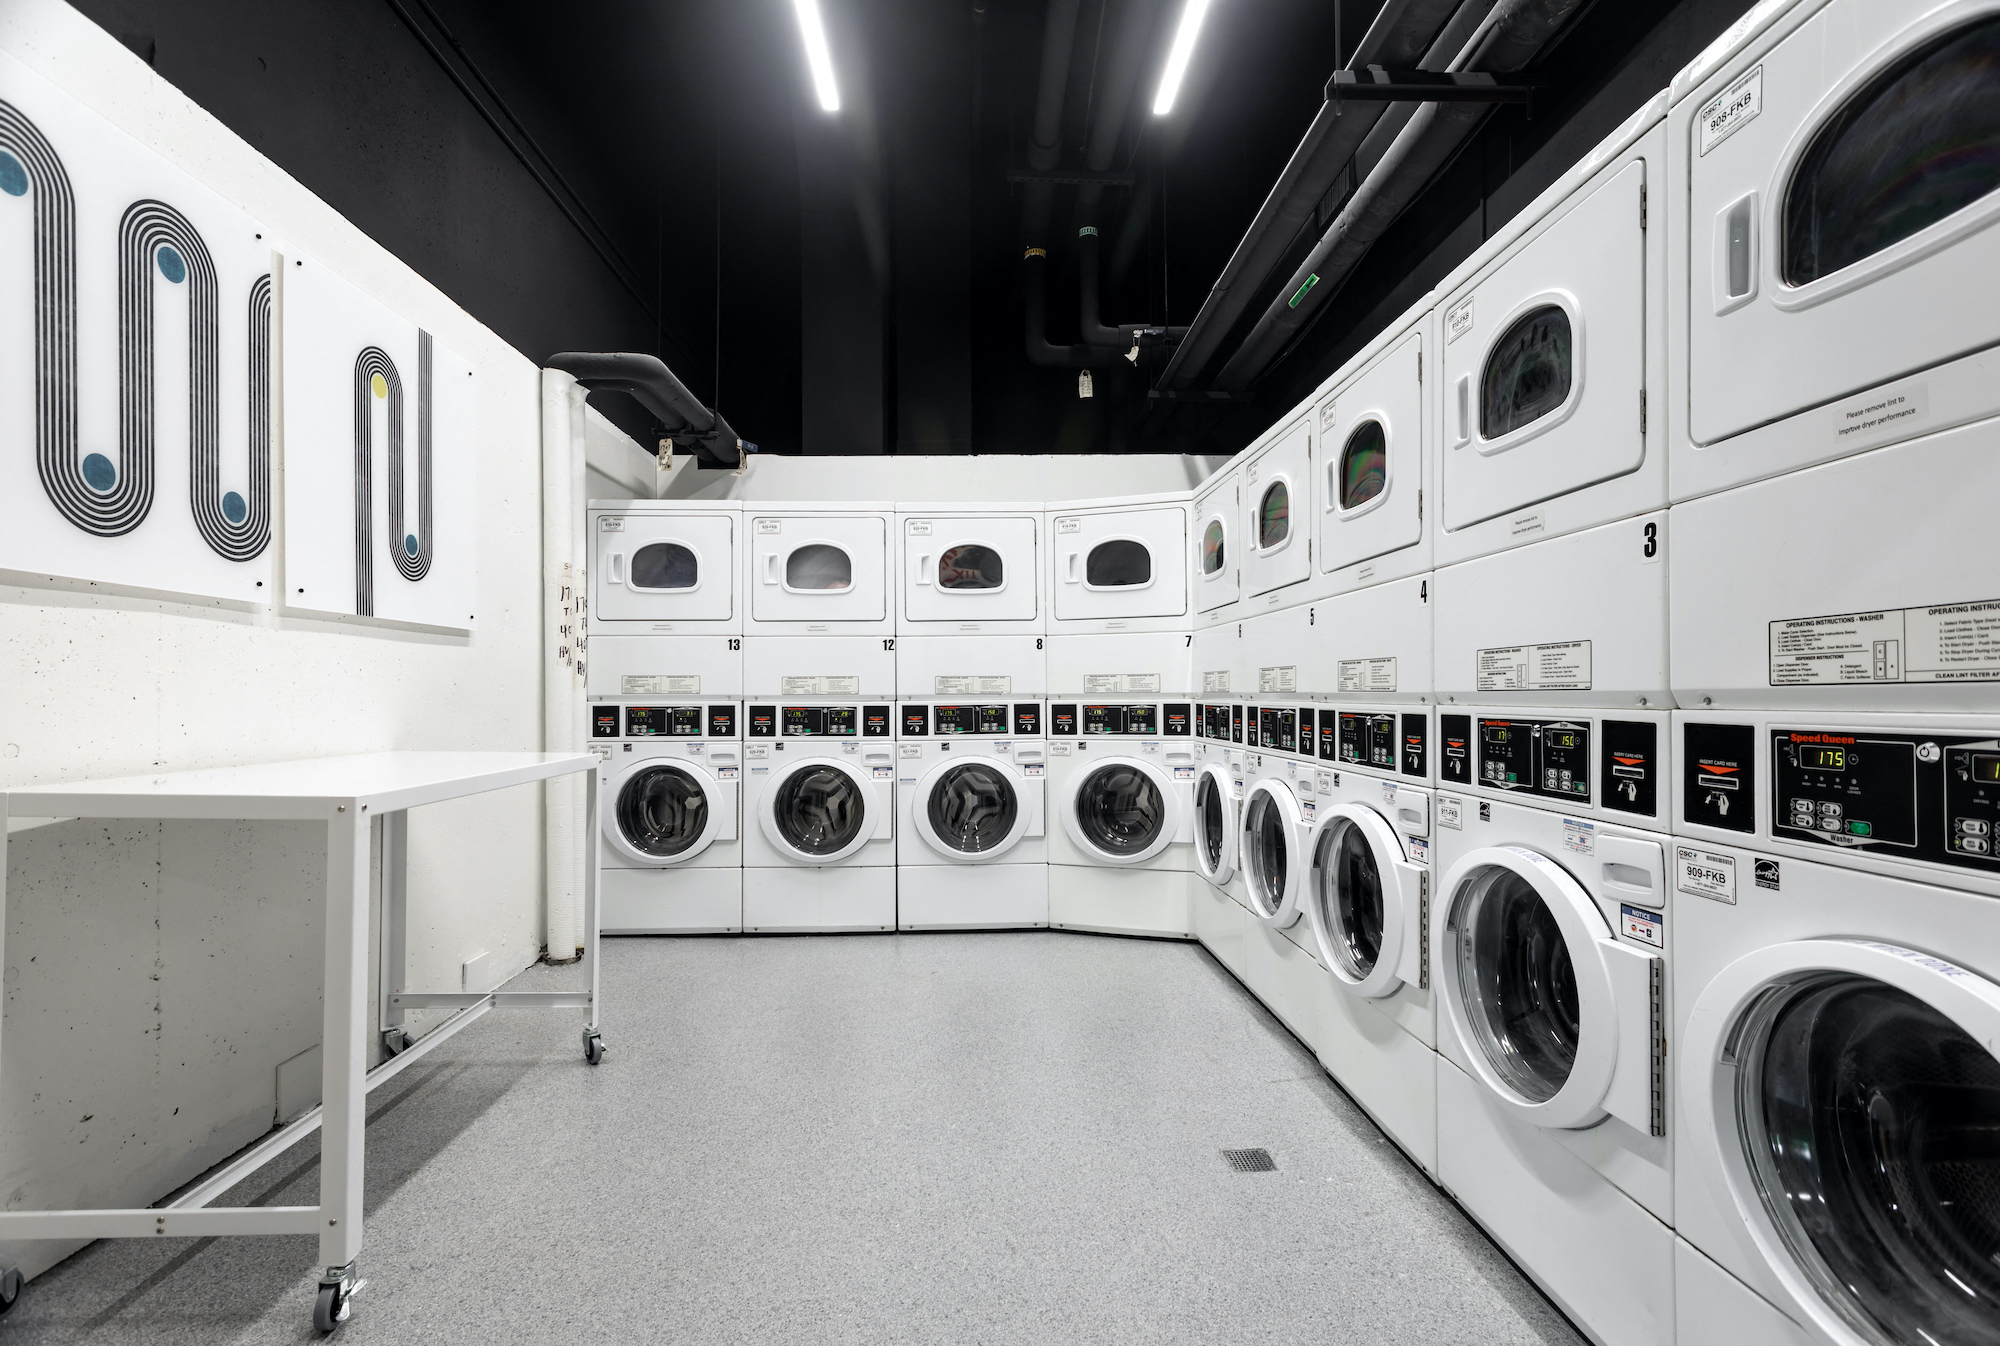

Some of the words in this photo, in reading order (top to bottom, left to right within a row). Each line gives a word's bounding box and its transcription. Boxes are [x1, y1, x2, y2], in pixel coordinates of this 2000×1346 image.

[1711, 93, 1751, 131] 908-FKB
[1846, 410, 1864, 419] Please
[1864, 402, 1886, 414] remove
[1887, 399, 1897, 407] lint
[1838, 425, 1861, 435] Improve
[1861, 419, 1877, 429] dryer
[1877, 407, 1916, 425] performance
[1644, 522, 1657, 558] 3
[1421, 580, 1427, 603] 4
[1310, 608, 1315, 626] 5
[1928, 605, 1969, 616] OPERATING
[1815, 616, 1855, 626] INSTRUCTIONS
[1858, 614, 1884, 622] WASHER
[727, 638, 741, 651] 13
[882, 639, 895, 651] 12
[1036, 638, 1043, 650] 8
[1185, 635, 1192, 648] 7
[1790, 733, 1821, 743] Speed
[1822, 734, 1855, 744] Queen
[1819, 751, 1843, 766] 175
[1829, 833, 1854, 844] Washer
[1679, 850, 1693, 858] CSC
[1686, 866, 1726, 884] 909-FKB
[1631, 909, 1651, 921] NOTICE
